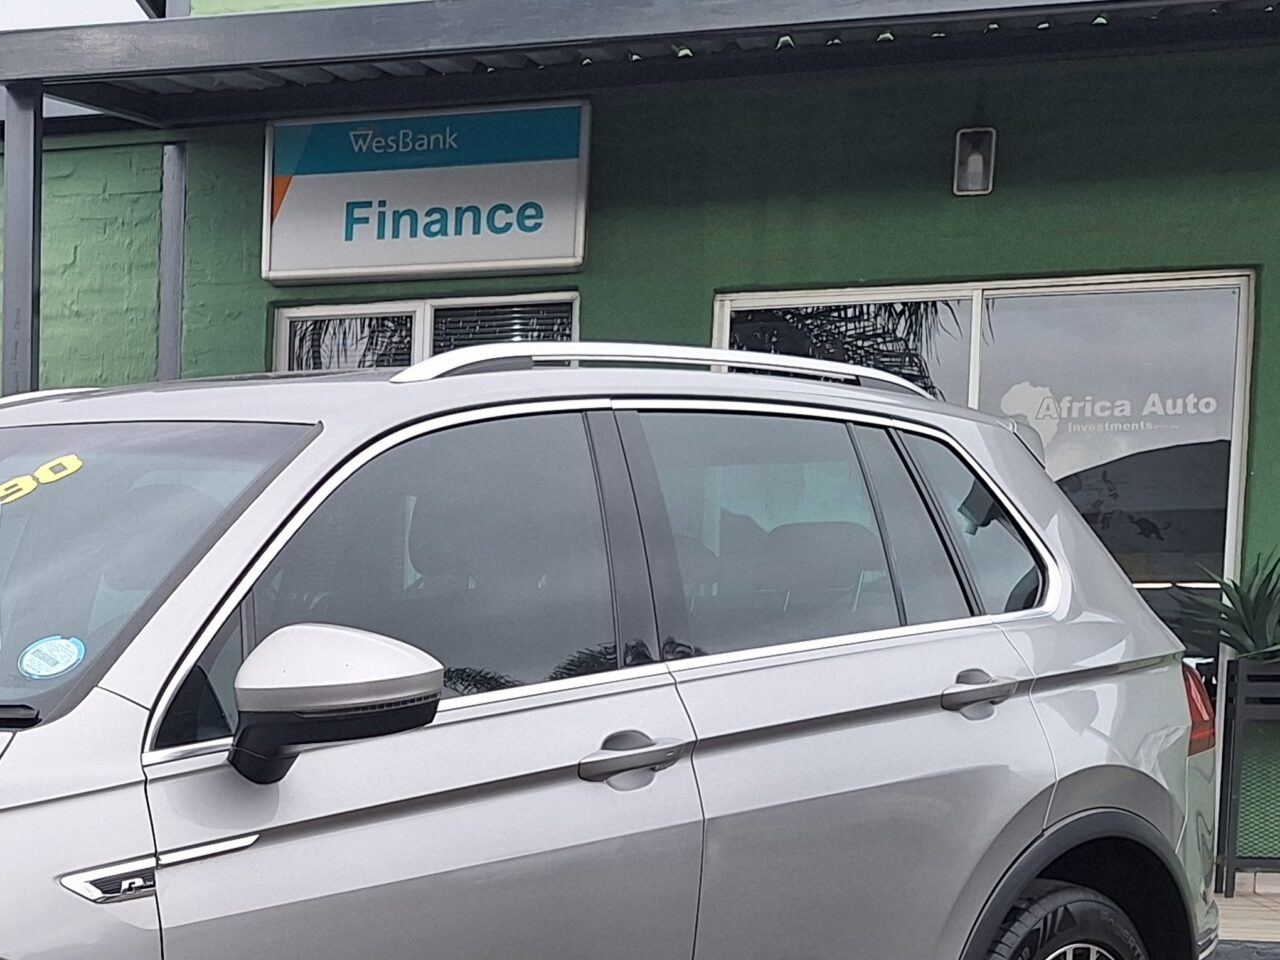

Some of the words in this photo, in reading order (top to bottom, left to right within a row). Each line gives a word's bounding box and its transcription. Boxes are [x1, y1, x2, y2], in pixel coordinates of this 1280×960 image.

[348, 126, 459, 153] WesBank
[344, 200, 545, 242] Finance
[1036, 395, 1132, 420] Africa
[1141, 392, 1218, 416] Auto
[1068, 420, 1152, 432] Investments
